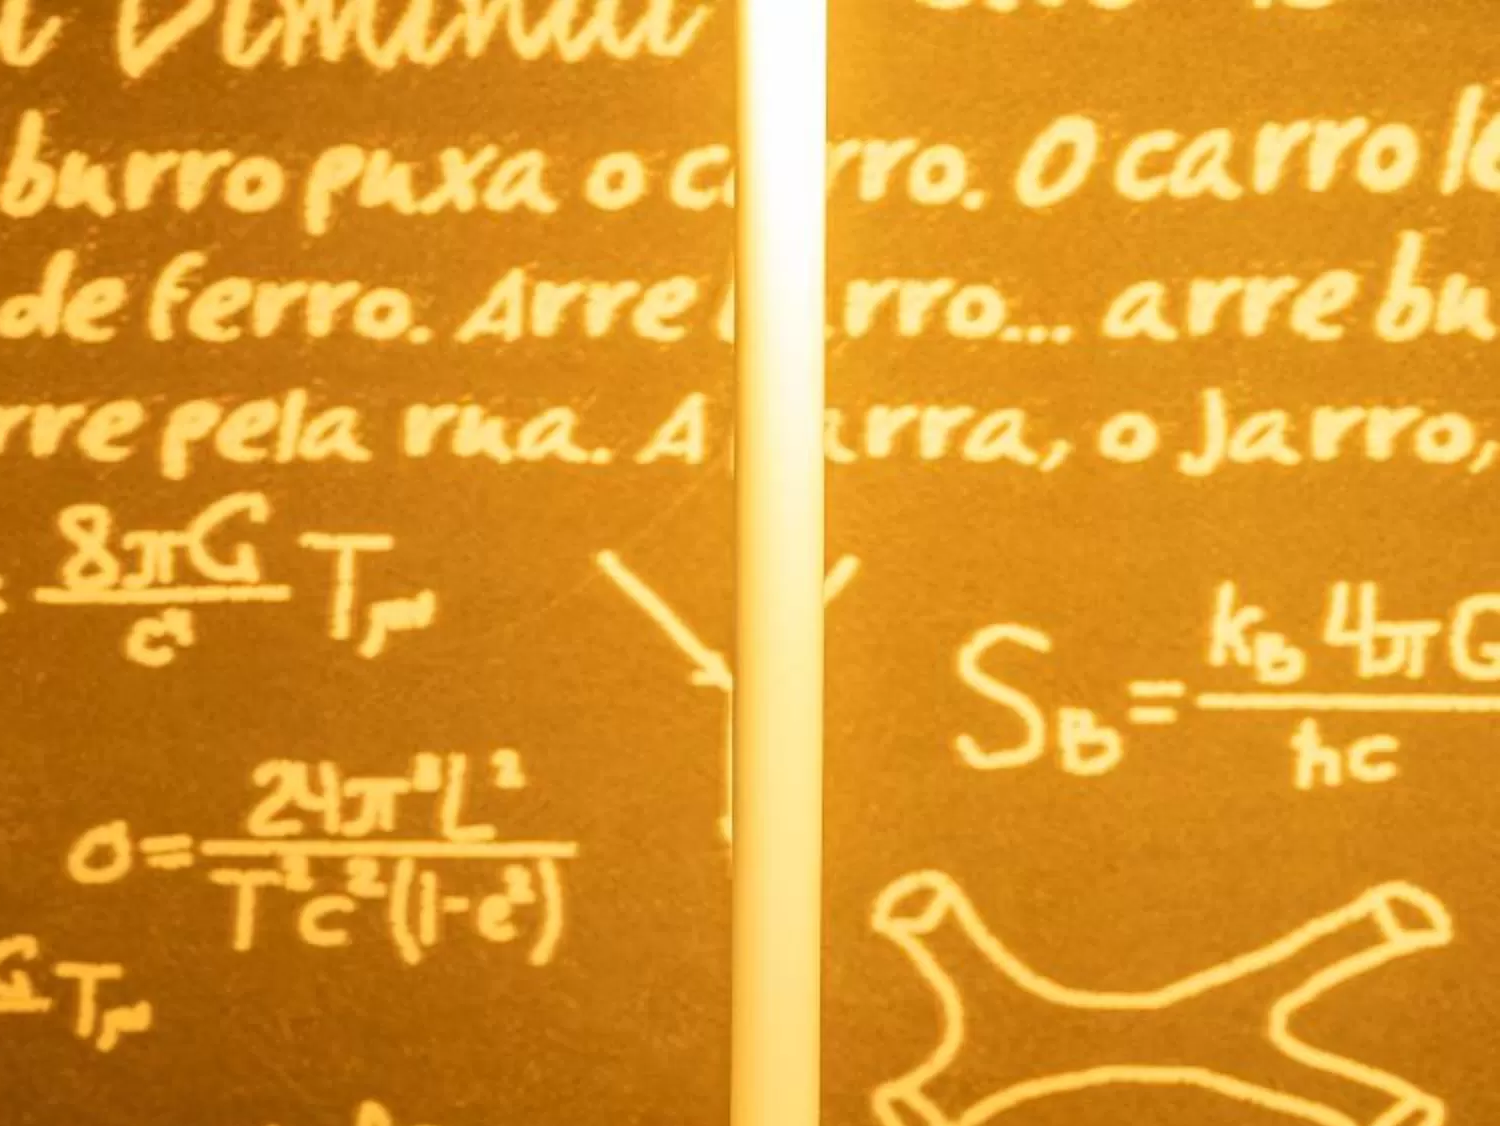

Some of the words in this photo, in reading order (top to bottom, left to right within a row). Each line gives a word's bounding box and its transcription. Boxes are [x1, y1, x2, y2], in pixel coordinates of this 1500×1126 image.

[305, 145, 557, 236] puxa
[585, 150, 645, 210] o
[1015, 115, 1100, 207] O
[1112, 115, 1420, 202] carro
[148, 252, 434, 345] ferro.
[455, 268, 700, 343] Arre
[1104, 270, 1358, 341] arre
[160, 388, 373, 480] pela
[403, 402, 610, 464] rua.
[636, 392, 706, 464] A
[1098, 410, 1158, 463] o
